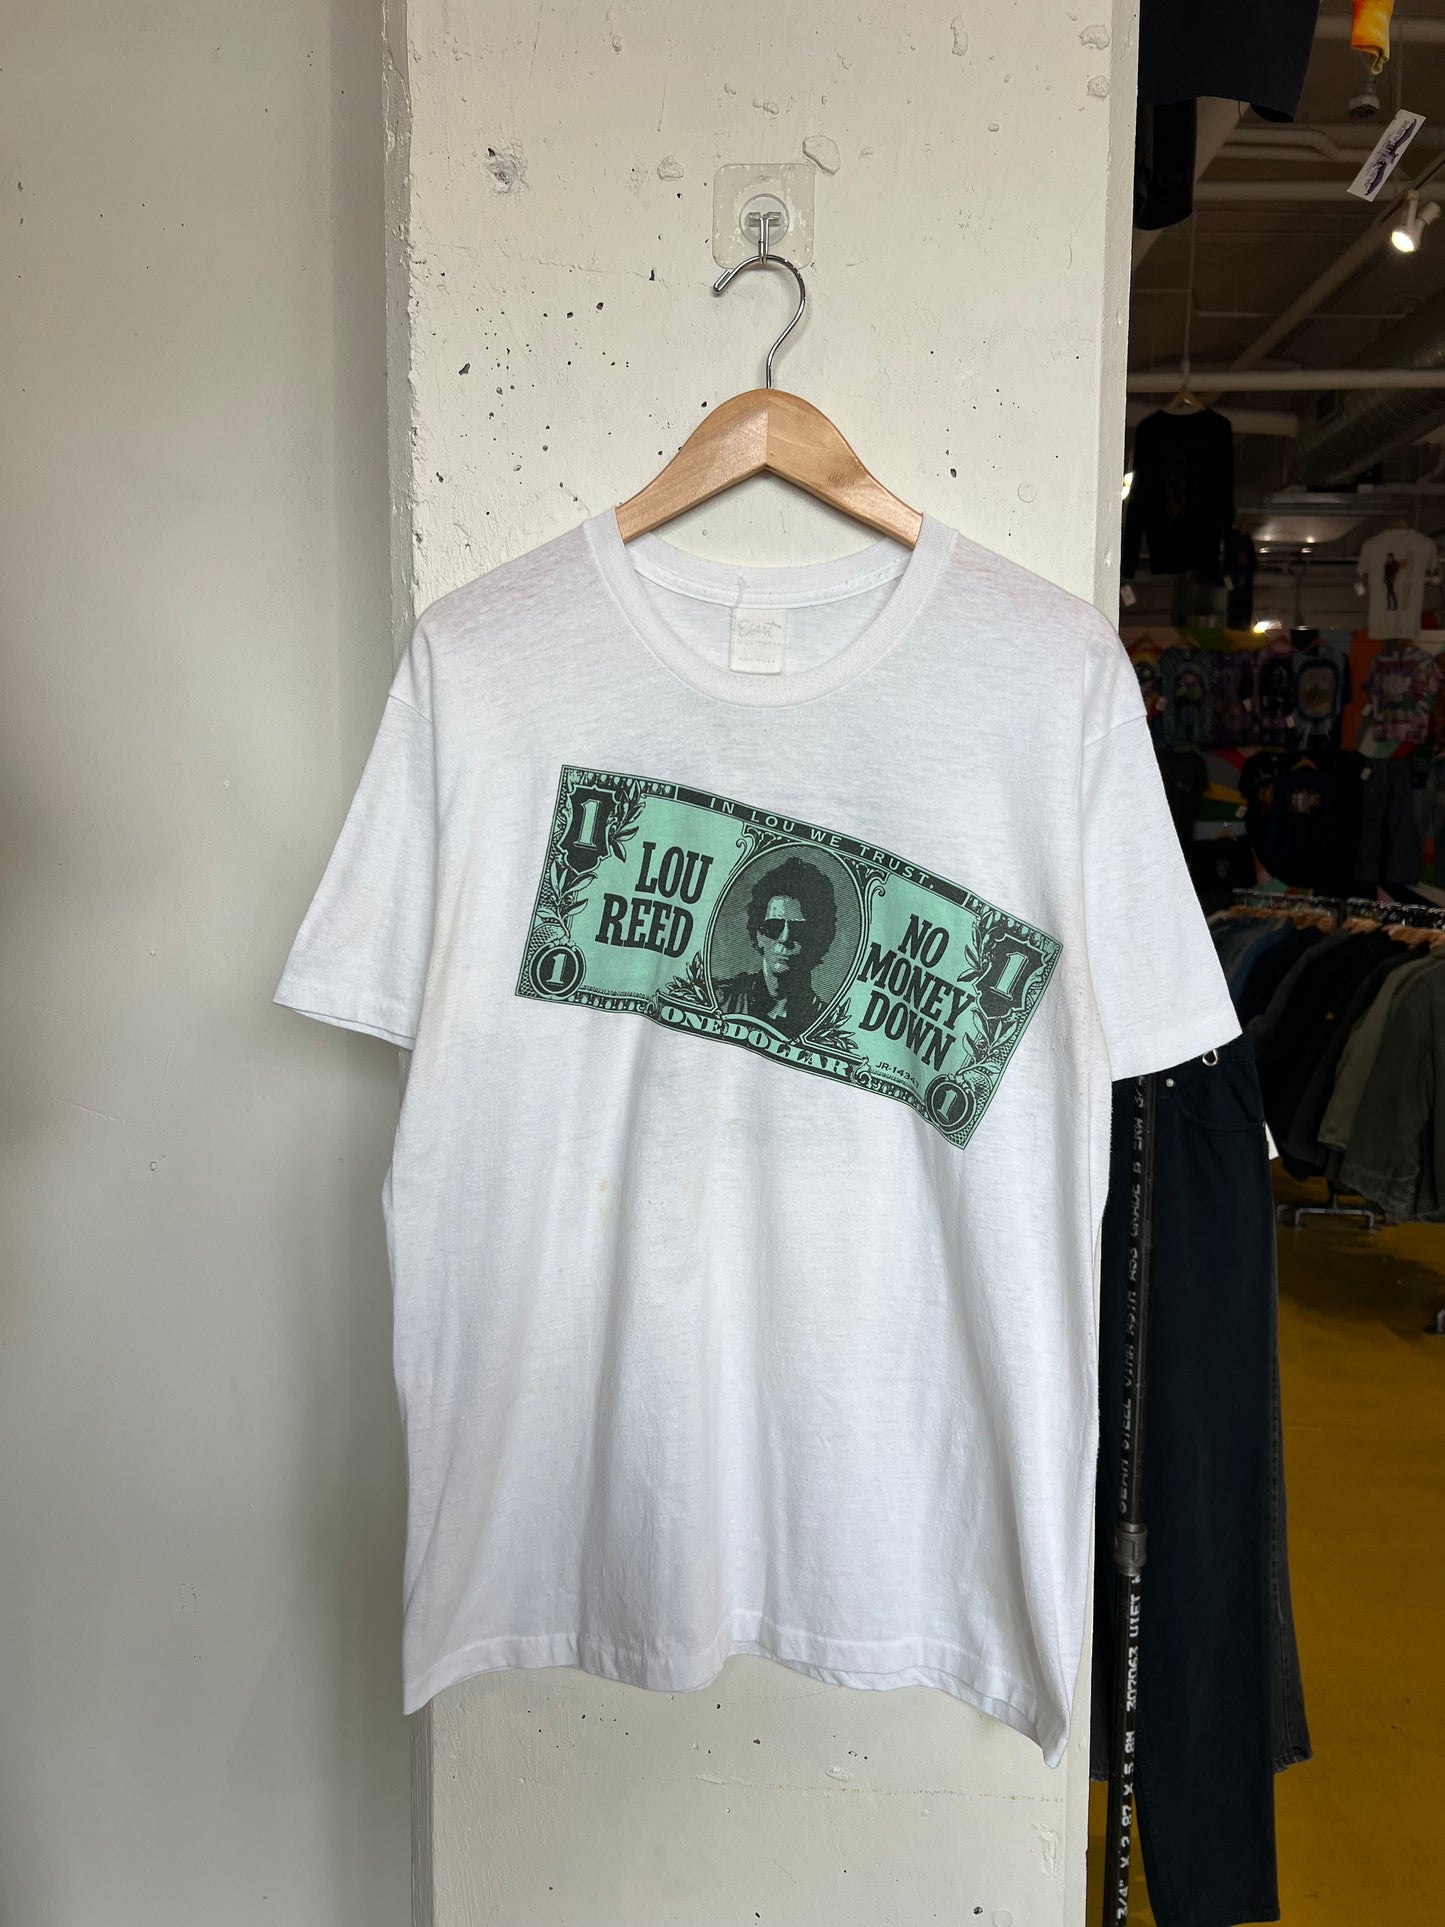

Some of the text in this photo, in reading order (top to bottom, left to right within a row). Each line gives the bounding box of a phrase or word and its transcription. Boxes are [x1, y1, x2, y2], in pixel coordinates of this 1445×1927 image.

[573, 799, 602, 850] 1
[709, 797, 735, 814] IN
[750, 810, 796, 833] LOU
[810, 828, 842, 848] WE
[635, 841, 714, 904] LOU
[595, 893, 694, 958] REED
[898, 913, 950, 969] NO
[545, 952, 568, 986] 1
[857, 941, 976, 1031] MONEY
[989, 951, 1029, 1001] 1
[660, 1005, 850, 1077] ONE DOLLAR
[858, 989, 956, 1072] DOWN
[937, 1090, 959, 1122] 1
